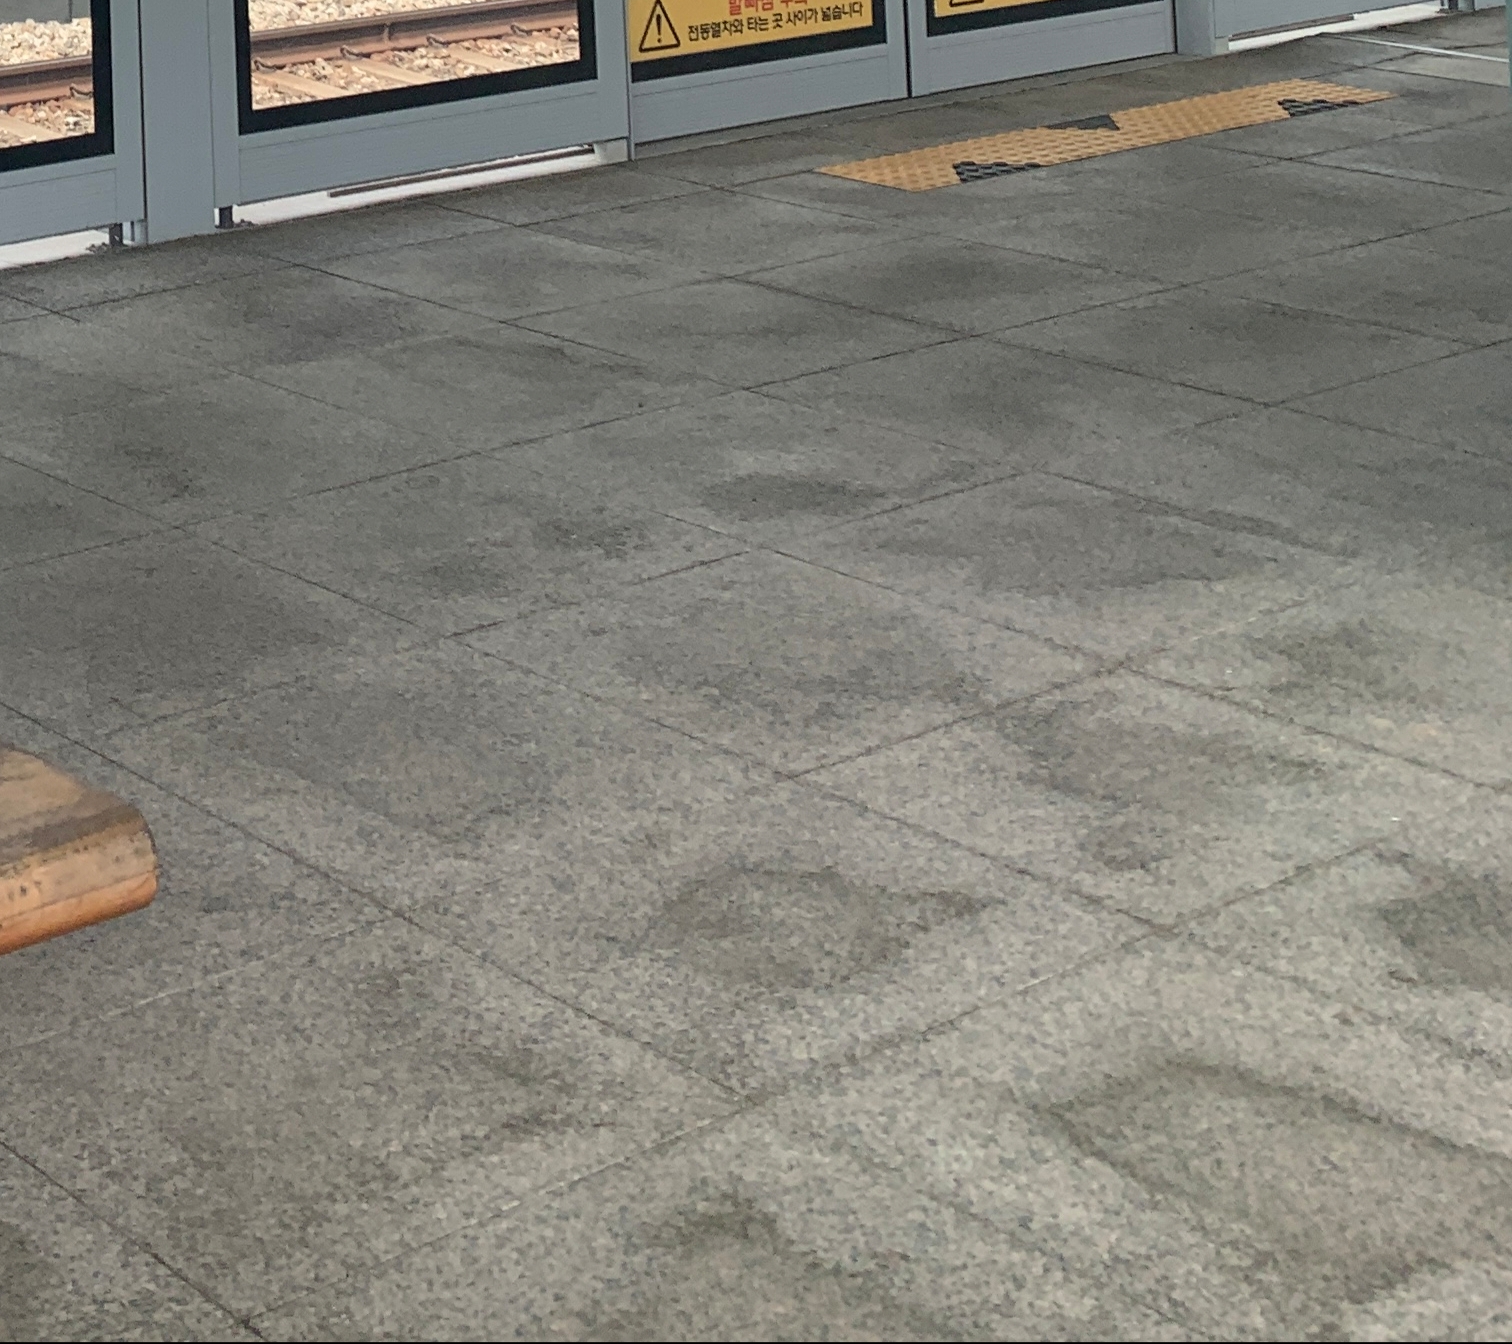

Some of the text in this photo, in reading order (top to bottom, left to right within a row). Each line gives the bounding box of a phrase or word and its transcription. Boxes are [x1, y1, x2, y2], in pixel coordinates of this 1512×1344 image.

[688, 1, 864, 42] 전동열차와 타는 곳 사이가 넓습니다
